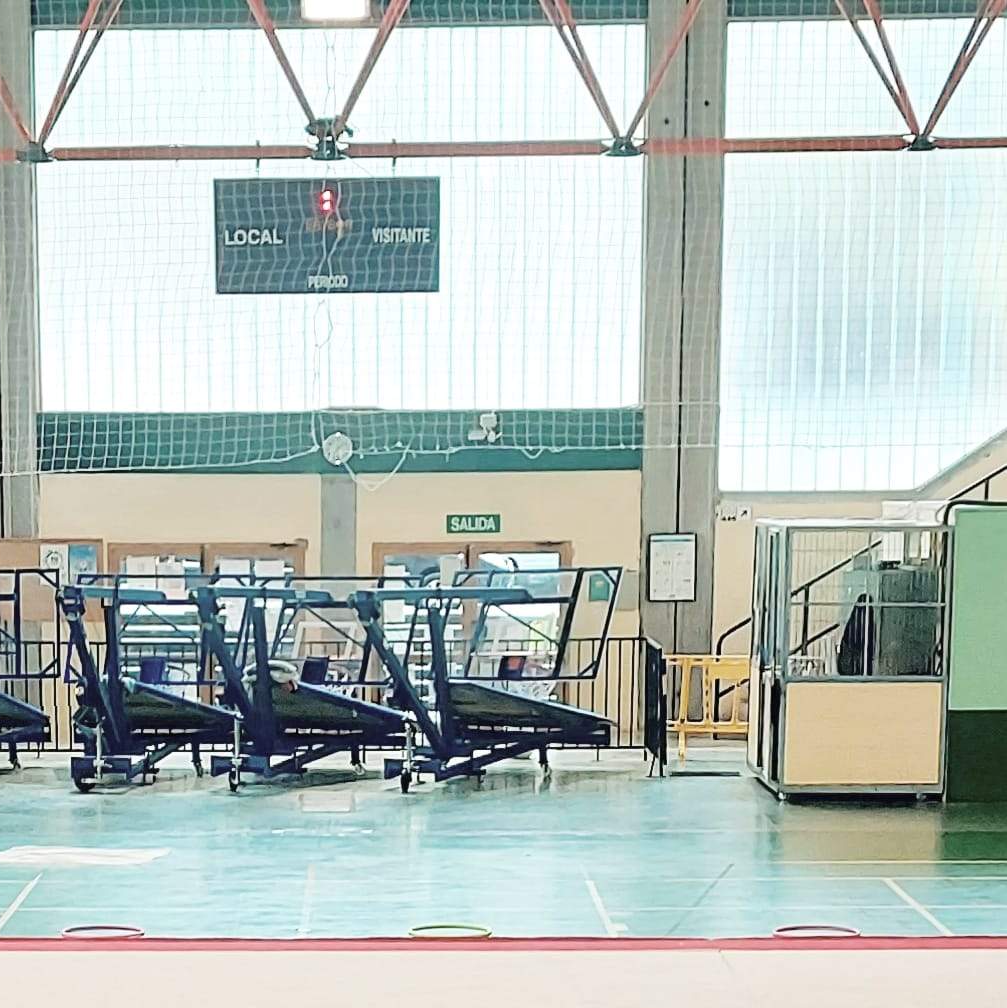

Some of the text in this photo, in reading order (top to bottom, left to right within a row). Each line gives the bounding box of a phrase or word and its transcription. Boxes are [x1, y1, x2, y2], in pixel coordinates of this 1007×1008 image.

[224, 228, 283, 245] LOCAL
[372, 227, 431, 243] VISITANTE
[450, 516, 496, 531] SALIDA
